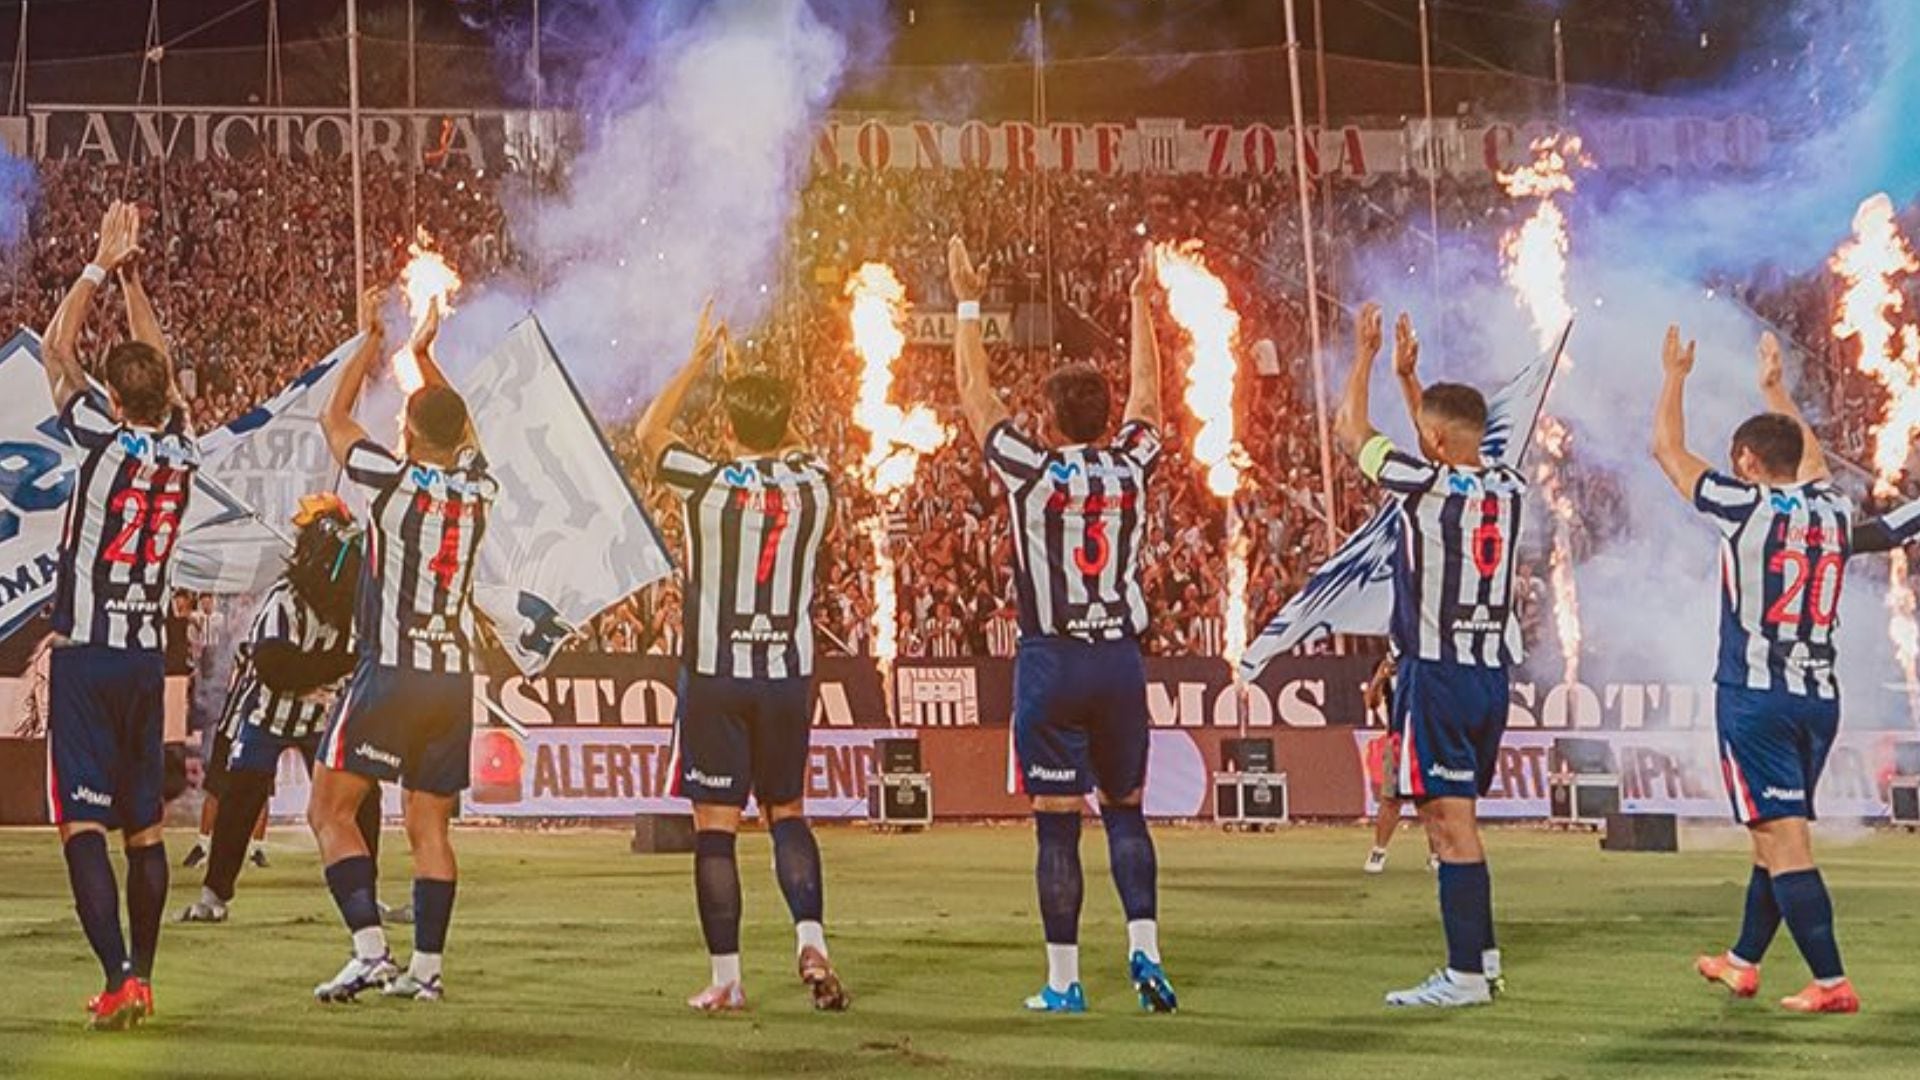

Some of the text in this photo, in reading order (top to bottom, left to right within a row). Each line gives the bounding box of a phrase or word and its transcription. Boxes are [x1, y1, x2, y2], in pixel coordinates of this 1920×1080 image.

[132, 113, 486, 168] VICTORIA
[912, 121, 1126, 178] NORTE
[1203, 124, 1369, 179] ZONA
[907, 317, 1001, 339] SALA
[1073, 519, 1110, 576] 3
[1766, 549, 1847, 627] 20
